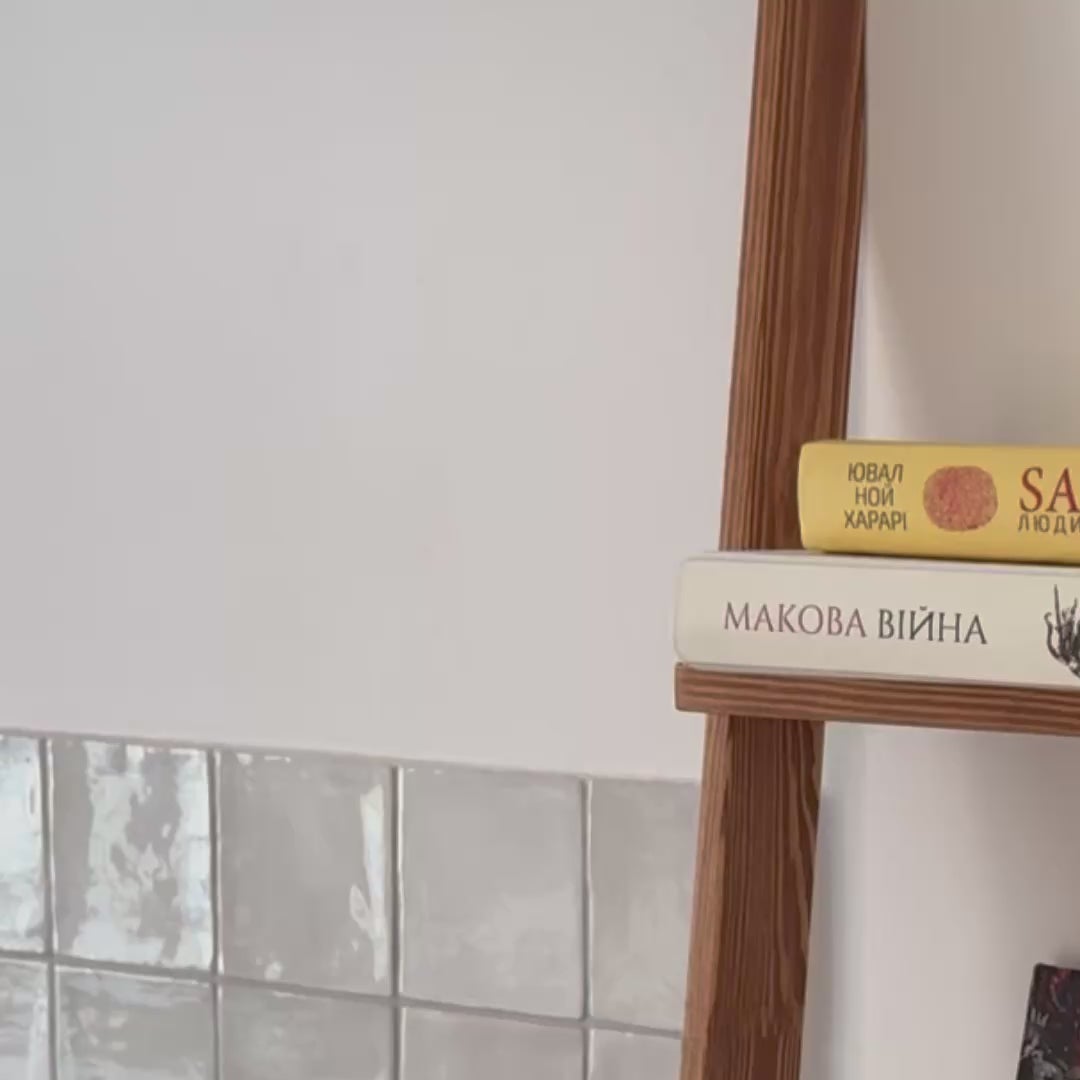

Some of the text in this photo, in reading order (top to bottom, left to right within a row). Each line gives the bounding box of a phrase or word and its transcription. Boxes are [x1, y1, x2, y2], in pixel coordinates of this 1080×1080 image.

[848, 461, 904, 485] ЮВАЛ
[854, 482, 895, 508] НОЙ
[844, 509, 908, 532] ХАРАРІ
[723, 601, 988, 645] МАКОВА ВІЙНА
